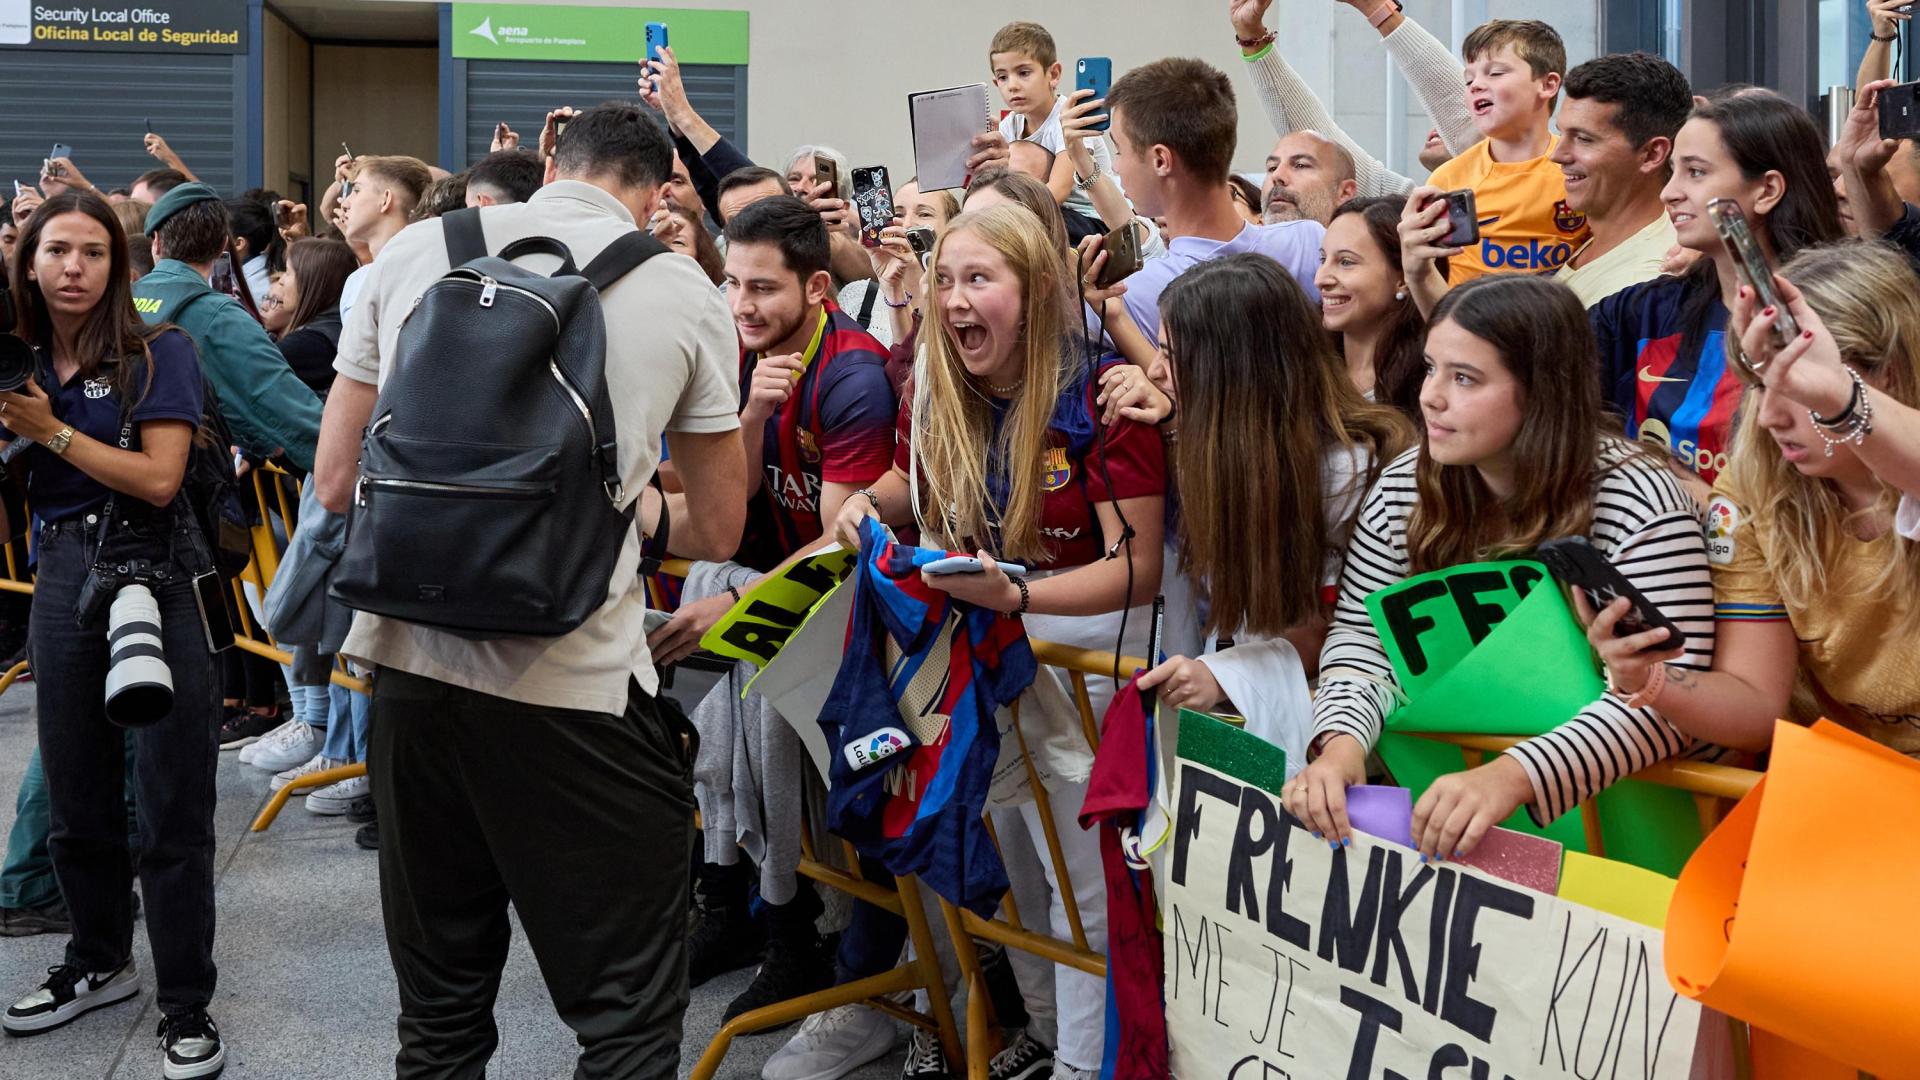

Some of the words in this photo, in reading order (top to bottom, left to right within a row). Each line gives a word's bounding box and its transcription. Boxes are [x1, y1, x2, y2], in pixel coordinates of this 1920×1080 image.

[34, 6, 89, 24] Security
[92, 8, 128, 23] Local
[131, 9, 170, 23] Office
[34, 25, 89, 41] Oficina
[93, 27, 134, 42] Local
[138, 28, 157, 42] de
[162, 28, 239, 46] Seguridad
[497, 26, 529, 37] aena
[1481, 236, 1572, 270] beko
[133, 297, 163, 314] DIA
[1677, 438, 1729, 474] Spo
[766, 463, 824, 498] TAR
[773, 490, 819, 512] WAY
[1043, 526, 1081, 540] ify
[1708, 541, 1730, 555] Liga
[1380, 564, 1545, 677] FE
[852, 743, 870, 767] LaL
[1171, 763, 1535, 1044] FRENKIE
[1540, 910, 1679, 1080] KUN
[1173, 903, 1233, 1028] ME
[1249, 944, 1311, 1059] JE
